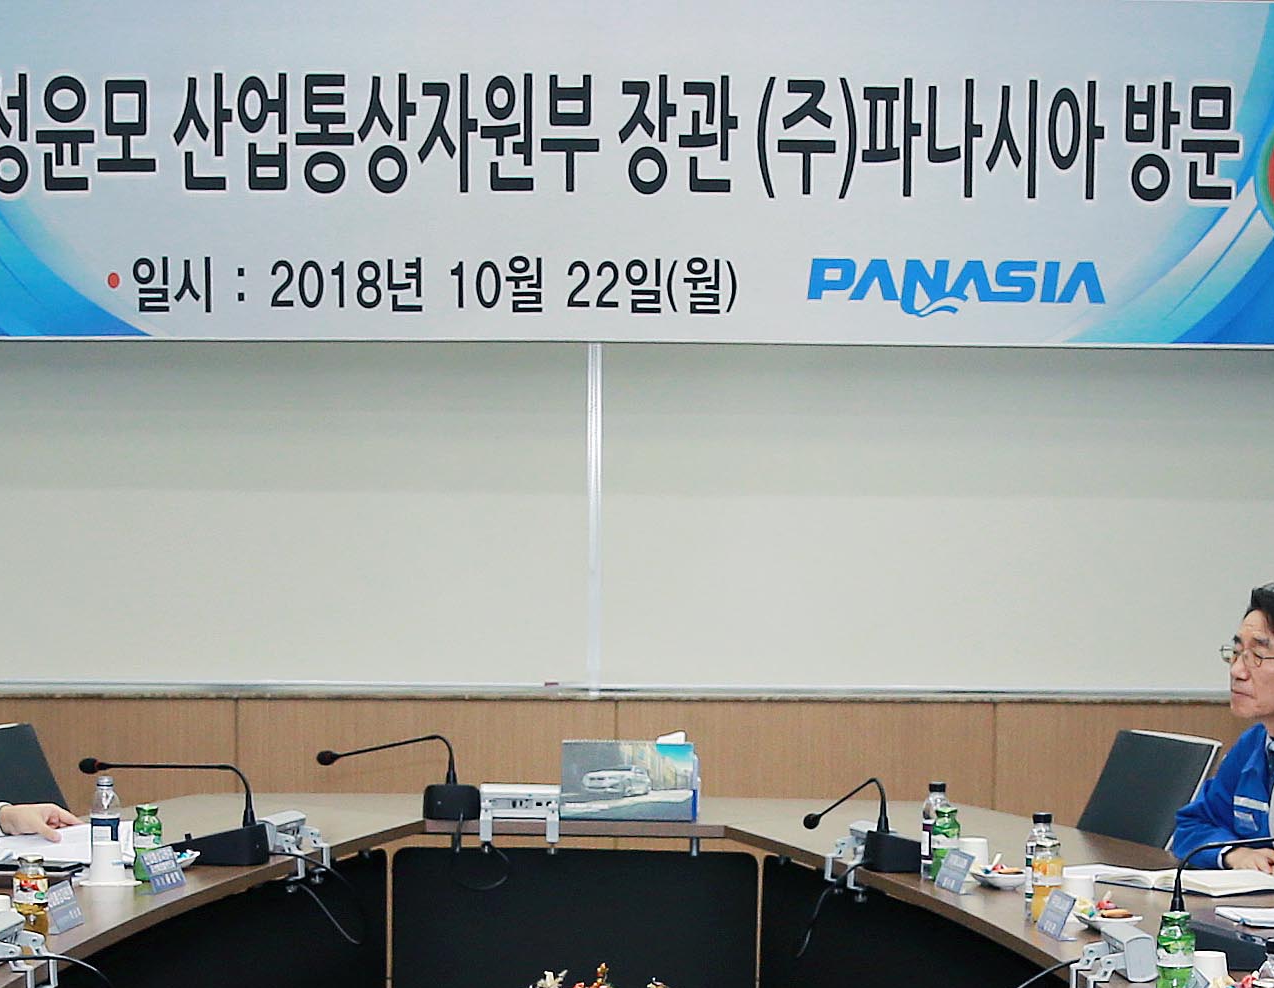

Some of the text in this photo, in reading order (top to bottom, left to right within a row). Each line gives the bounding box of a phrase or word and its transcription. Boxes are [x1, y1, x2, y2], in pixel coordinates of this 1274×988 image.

[173, 72, 600, 194] 산업통상자원부
[618, 74, 739, 195] 장관
[757, 77, 1105, 200] (주)파나시아
[1125, 82, 1241, 201] 방문
[132, 256, 213, 312] 일시
[270, 256, 423, 312] 2018년
[450, 255, 544, 312] 10월
[566, 256, 737, 314] 22일(월)
[806, 257, 1106, 316] PANASIA
